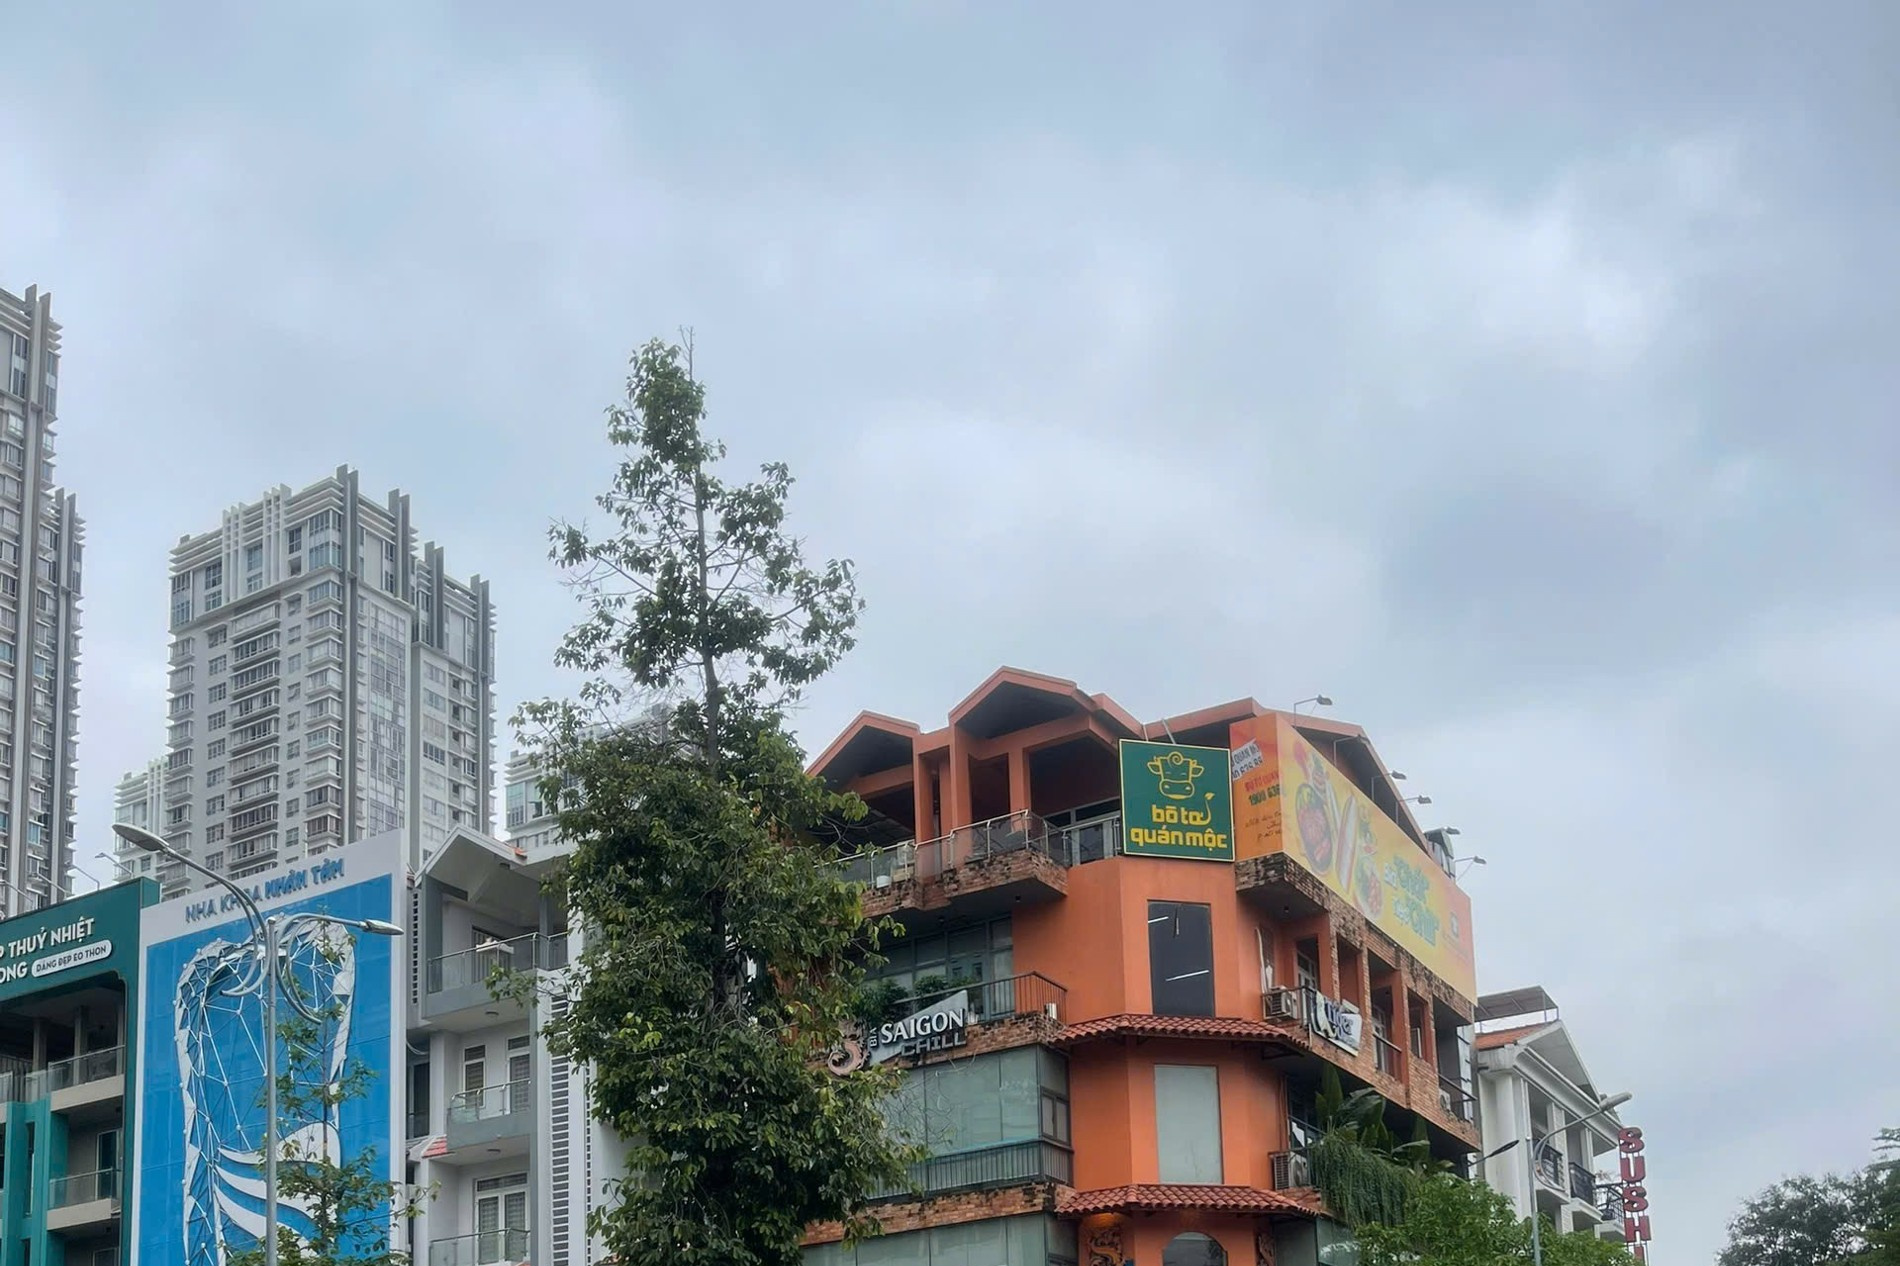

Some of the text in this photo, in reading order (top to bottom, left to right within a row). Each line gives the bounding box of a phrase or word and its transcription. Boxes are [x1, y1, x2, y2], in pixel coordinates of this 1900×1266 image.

[1130, 825, 1228, 851] quán mộc
[8, 926, 47, 958] THUỶ
[50, 916, 94, 943] NHIỆT
[869, 1027, 878, 1048] BIA
[880, 1008, 964, 1044] SAIGON
[901, 1032, 967, 1056] CHILL
